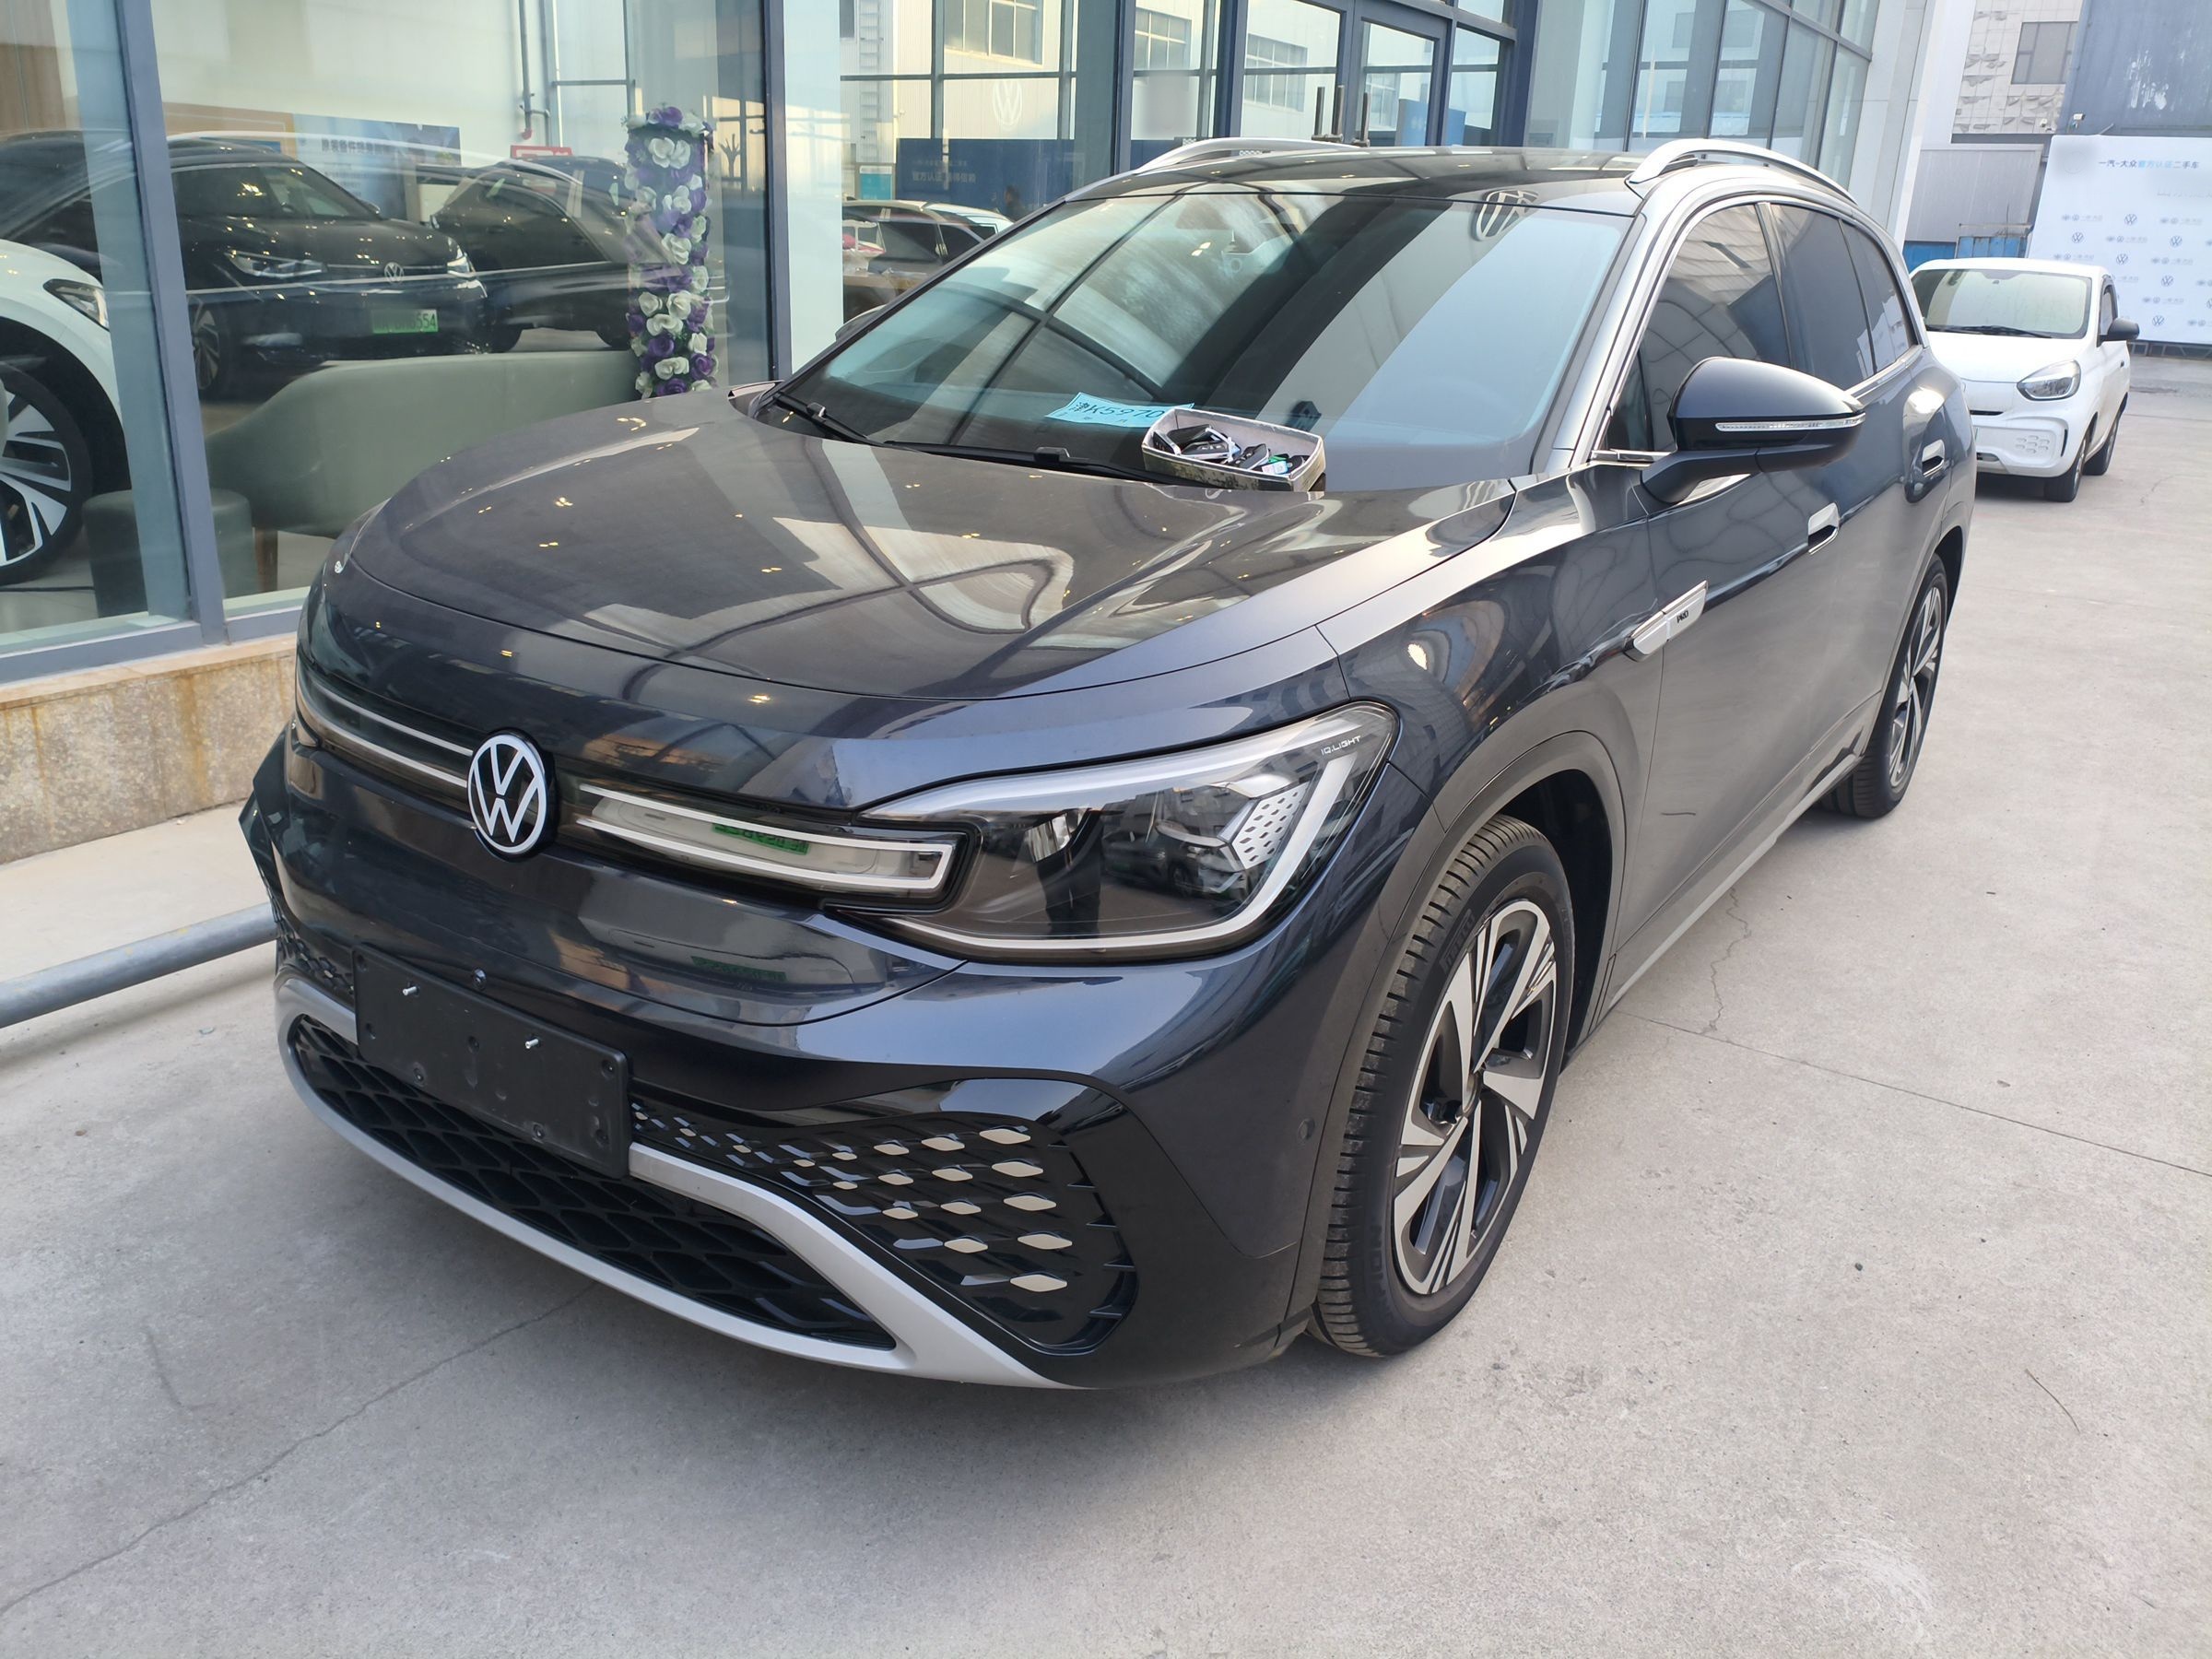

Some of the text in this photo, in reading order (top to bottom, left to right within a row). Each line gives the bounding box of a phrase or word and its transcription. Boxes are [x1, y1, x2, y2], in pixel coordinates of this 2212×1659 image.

[1677, 609, 1689, 623] PRO
[1321, 735, 1361, 756] IQ.LIGHT
[467, 735, 547, 853] VW
